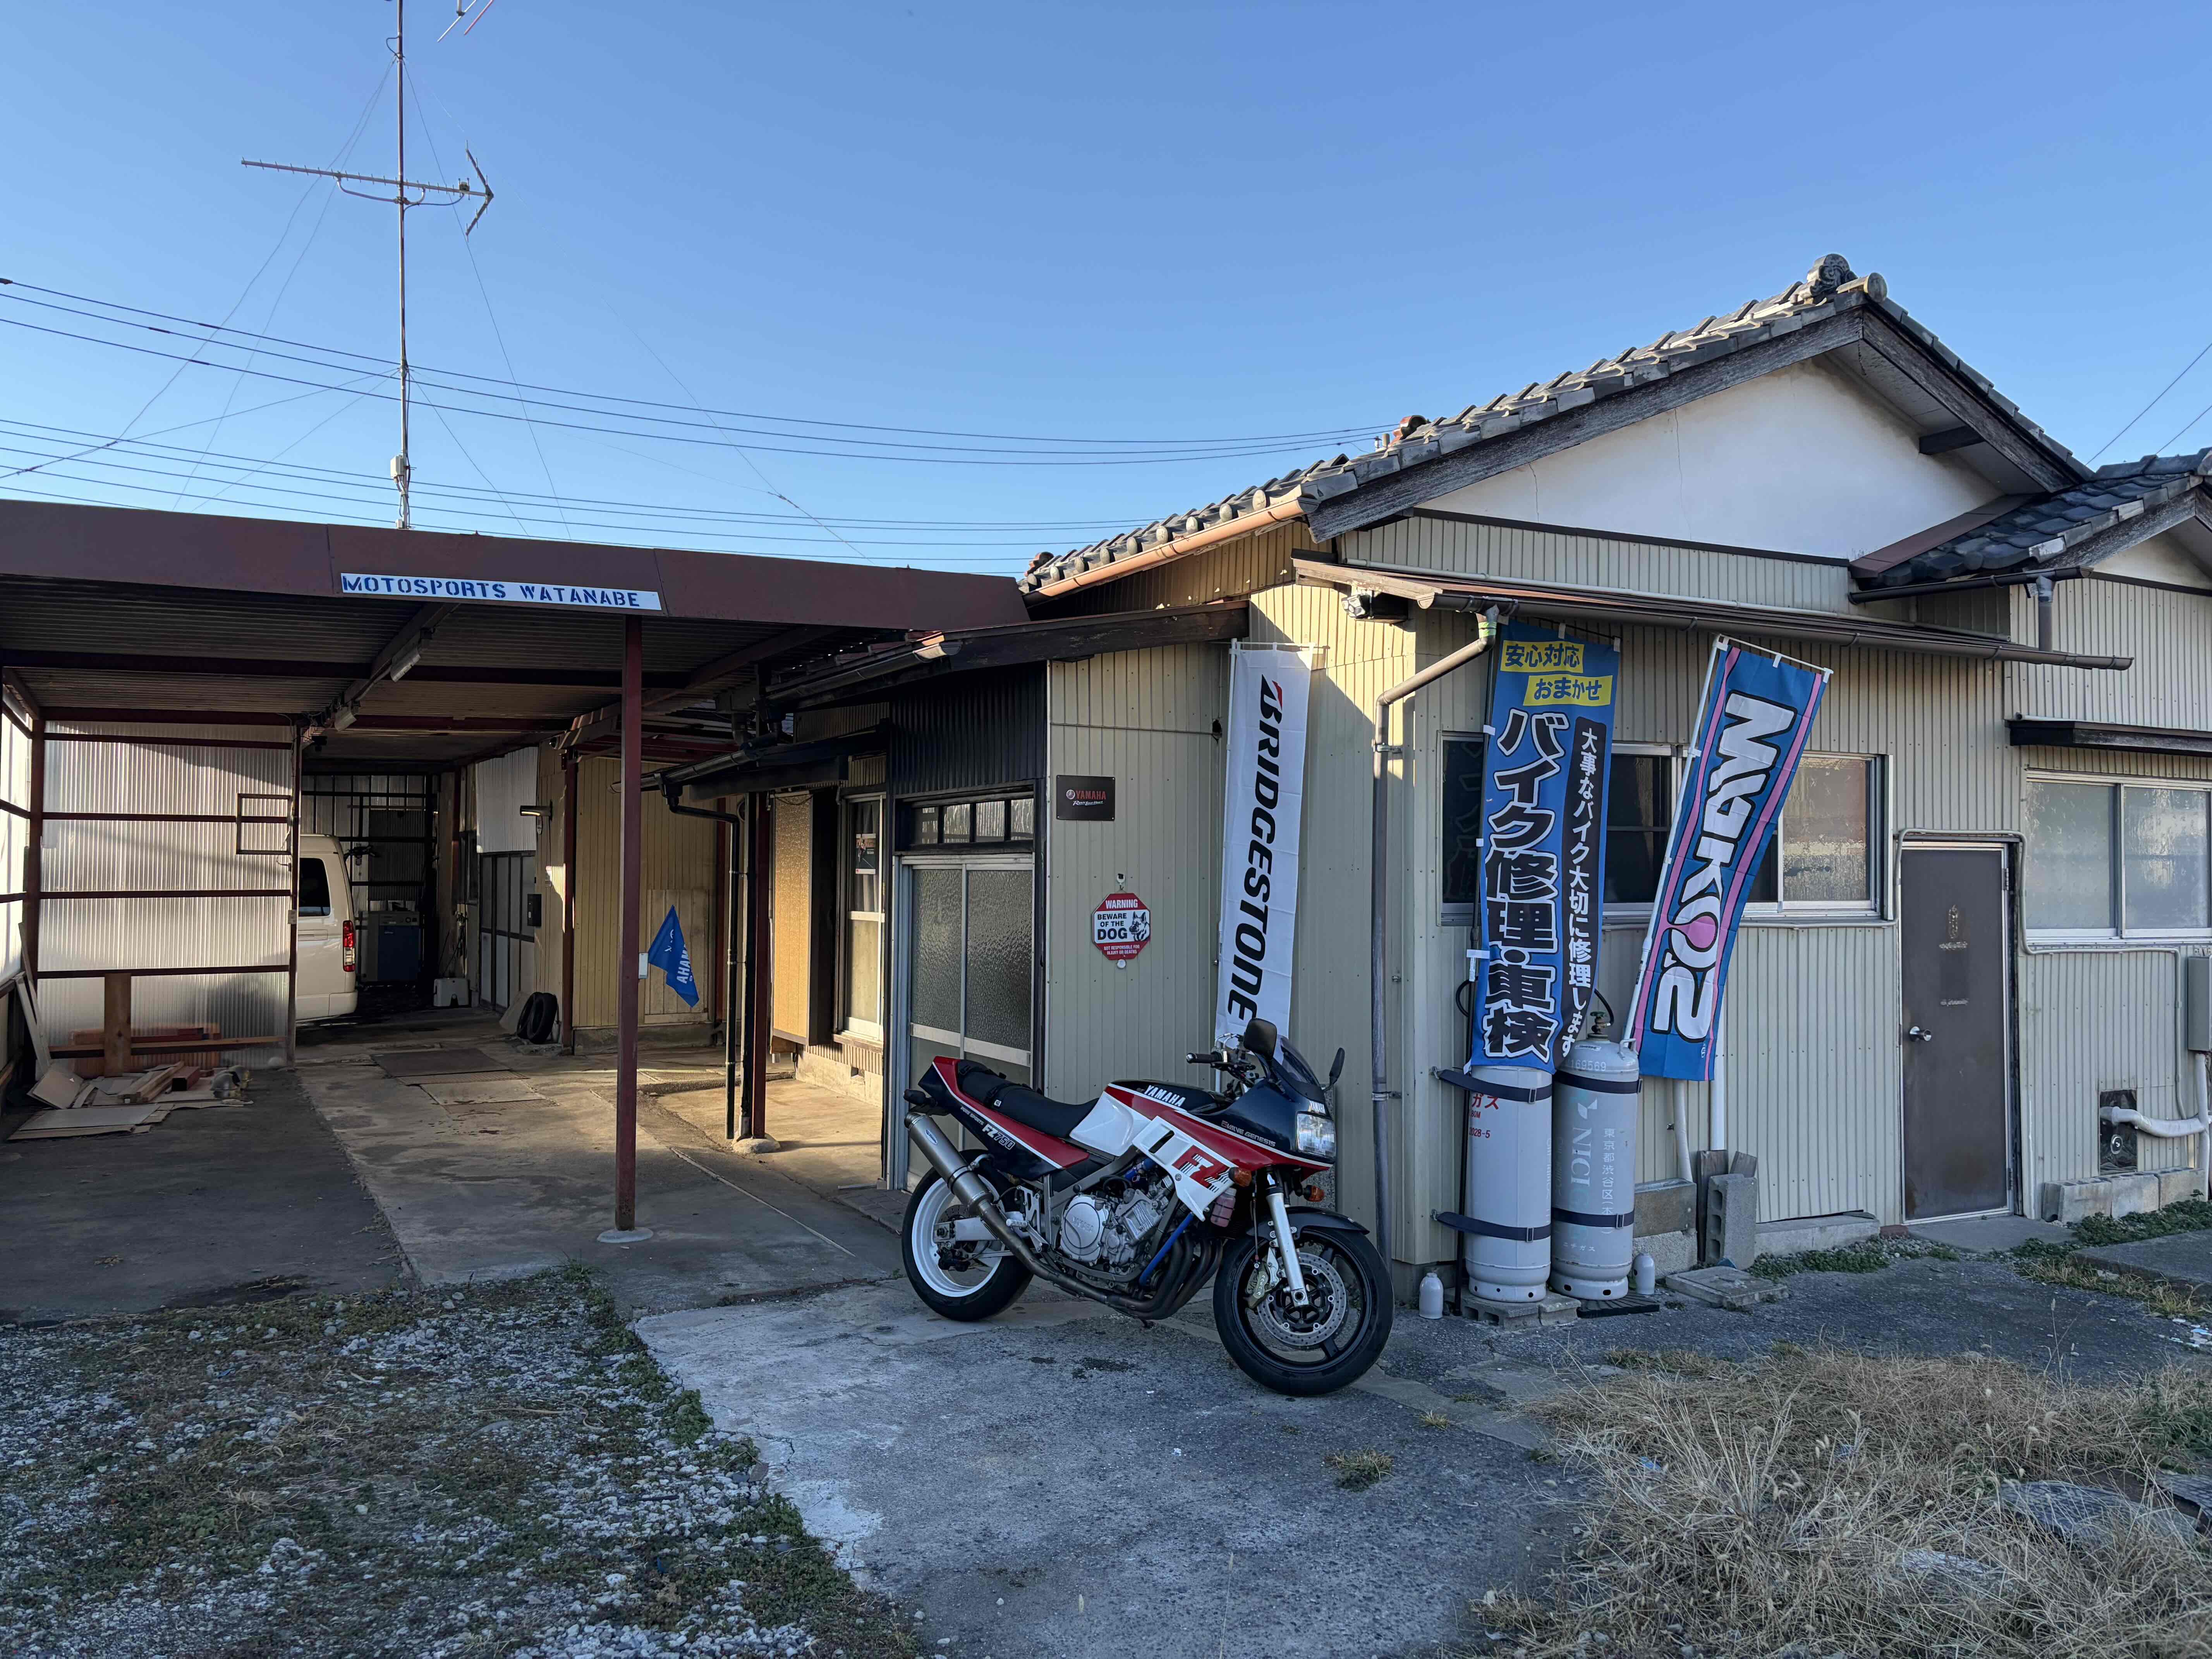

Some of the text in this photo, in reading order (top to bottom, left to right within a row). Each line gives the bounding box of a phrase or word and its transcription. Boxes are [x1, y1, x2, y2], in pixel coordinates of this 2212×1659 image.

[342, 576, 640, 607] MOTOSPORTS WATANABE
[1505, 644, 1580, 667] 安心対応
[1534, 677, 1602, 700] おまかせ
[1076, 790, 1106, 799] YAMAHA
[1228, 674, 1282, 1020] BRIDGESTONE
[1106, 899, 1138, 909] WARNING
[1562, 728, 1598, 1058] 大事なバイク大切に修理します
[1097, 928, 1127, 940] DOG
[1144, 1085, 1186, 1107] YAMAHA
[982, 1124, 1015, 1150] FZ750
[1244, 1132, 1276, 1147] GENESIS
